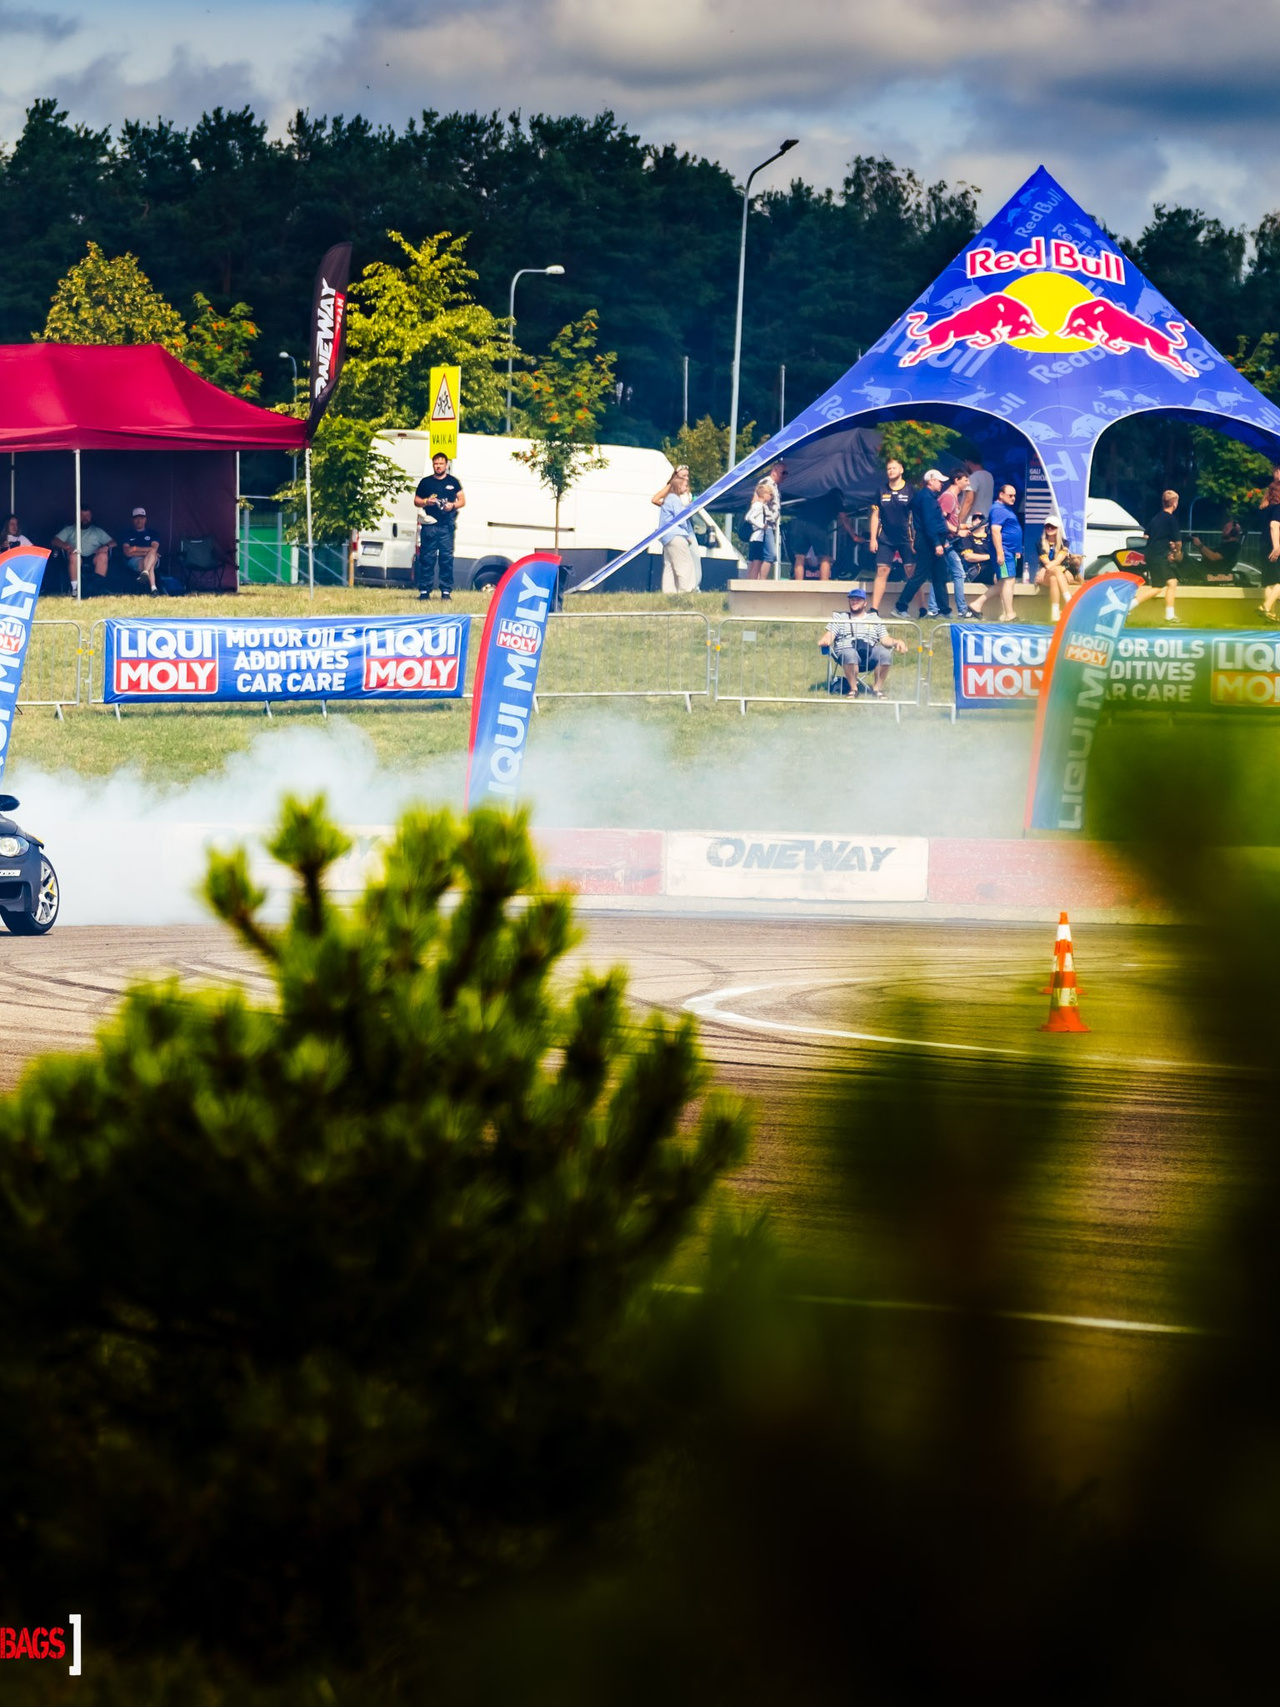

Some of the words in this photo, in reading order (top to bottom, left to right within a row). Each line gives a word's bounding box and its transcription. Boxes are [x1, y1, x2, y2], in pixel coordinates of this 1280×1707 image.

[966, 236, 1046, 278] Red
[1051, 239, 1126, 286] Bull
[814, 394, 846, 420] Re
[992, 391, 1027, 417] ull
[431, 434, 456, 445] VAIKAI
[226, 628, 302, 648] MOTOR
[307, 628, 357, 648] OILS
[502, 619, 538, 639] LIQUI
[120, 629, 212, 660] LIQUI
[370, 627, 456, 658] LIQUI
[498, 633, 537, 653] MOLY
[1154, 640, 1205, 659] OILS
[234, 650, 349, 670] ADDITIVES
[120, 662, 216, 691] MOLY
[370, 659, 458, 688] MOLY
[1110, 661, 1196, 682] DITIVES
[237, 673, 283, 693] CAR
[287, 672, 346, 692] CARE
[1132, 684, 1193, 702] CARE
